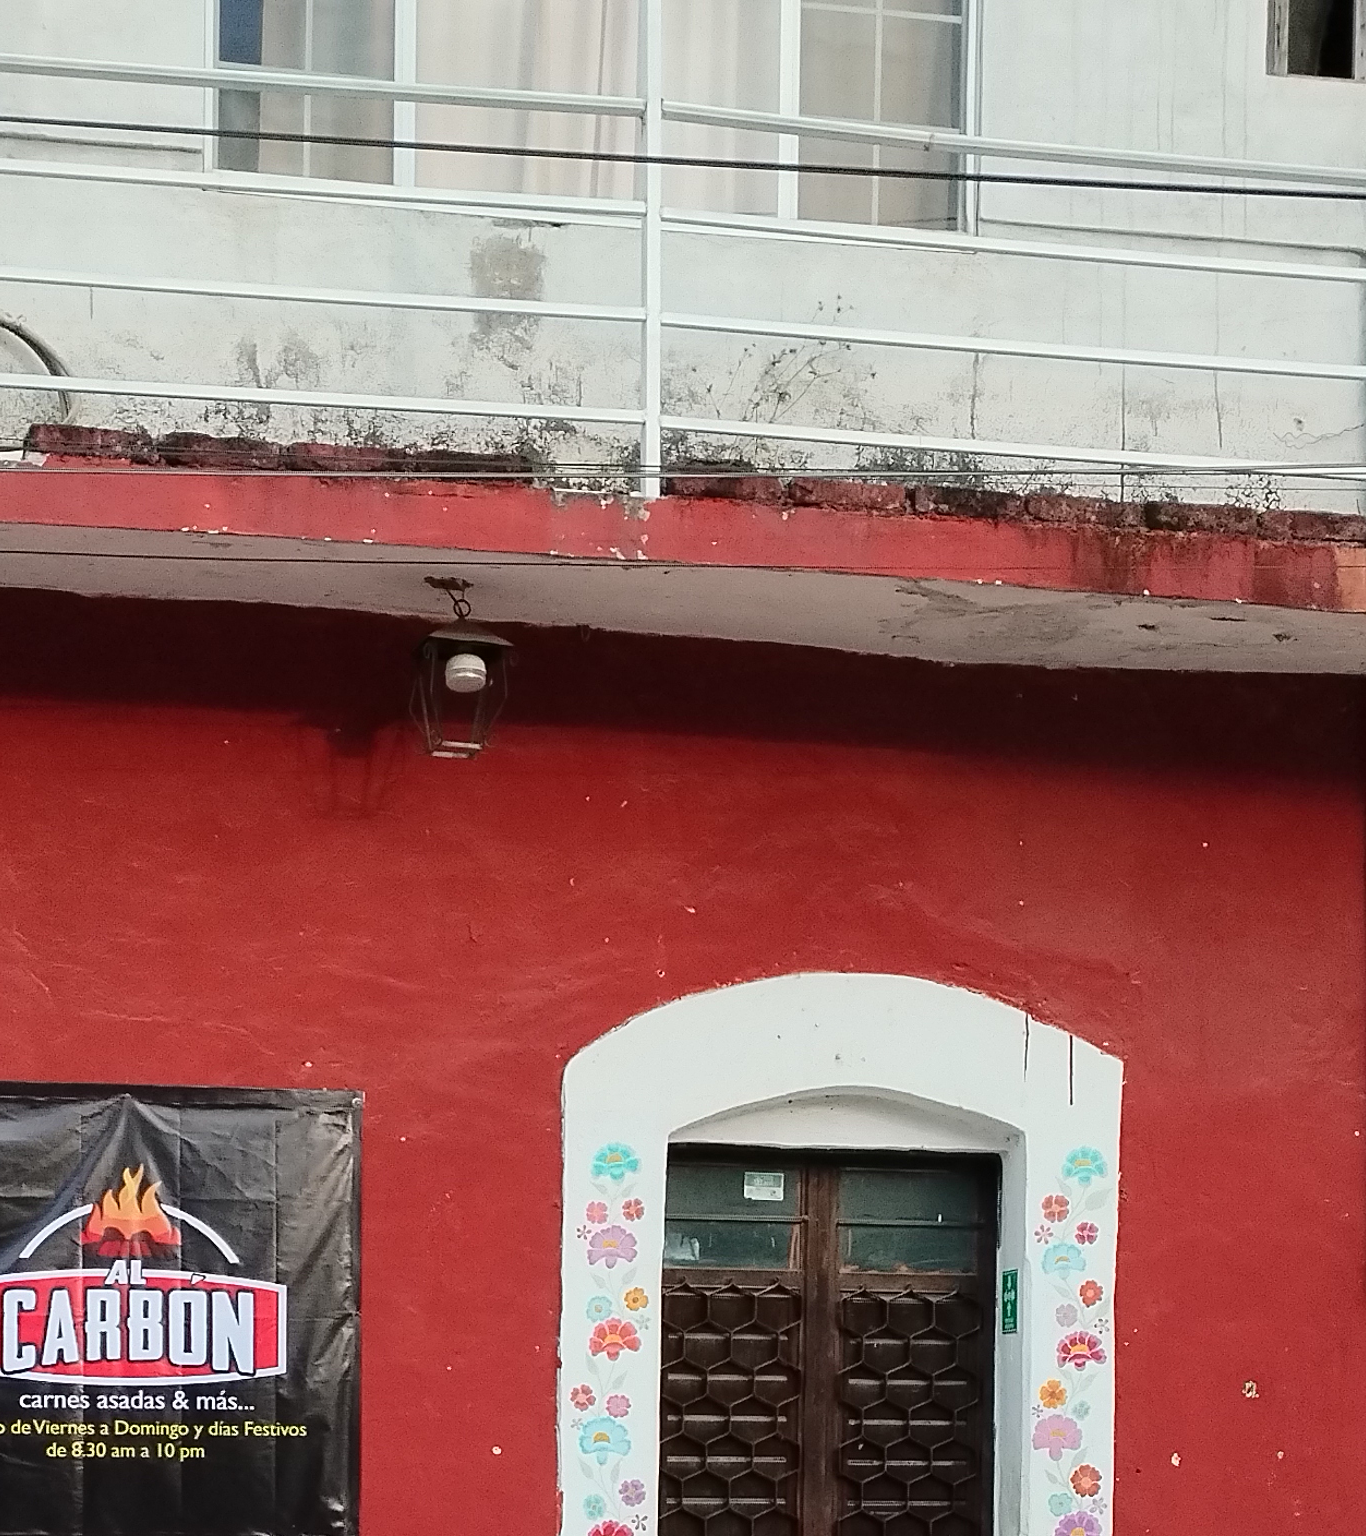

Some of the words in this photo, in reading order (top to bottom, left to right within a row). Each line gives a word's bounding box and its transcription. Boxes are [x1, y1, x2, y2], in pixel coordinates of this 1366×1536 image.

[104, 1259, 147, 1285] AL
[1, 1273, 255, 1375] CARBÓN
[19, 1393, 90, 1409] carnes
[96, 1389, 165, 1410] asadas
[172, 1390, 190, 1410] &
[196, 1389, 255, 1411] más...
[10, 1418, 32, 1435] de
[32, 1419, 95, 1436] Viernes
[99, 1424, 110, 1436] a
[114, 1419, 190, 1440] Domingo
[192, 1425, 204, 1440] y
[208, 1420, 239, 1437] días
[244, 1420, 308, 1437] Festivos
[45, 1442, 67, 1458] de
[111, 1446, 136, 1458] am
[140, 1446, 150, 1458] a
[157, 1442, 175, 1458] 10
[179, 1446, 205, 1462] pm
